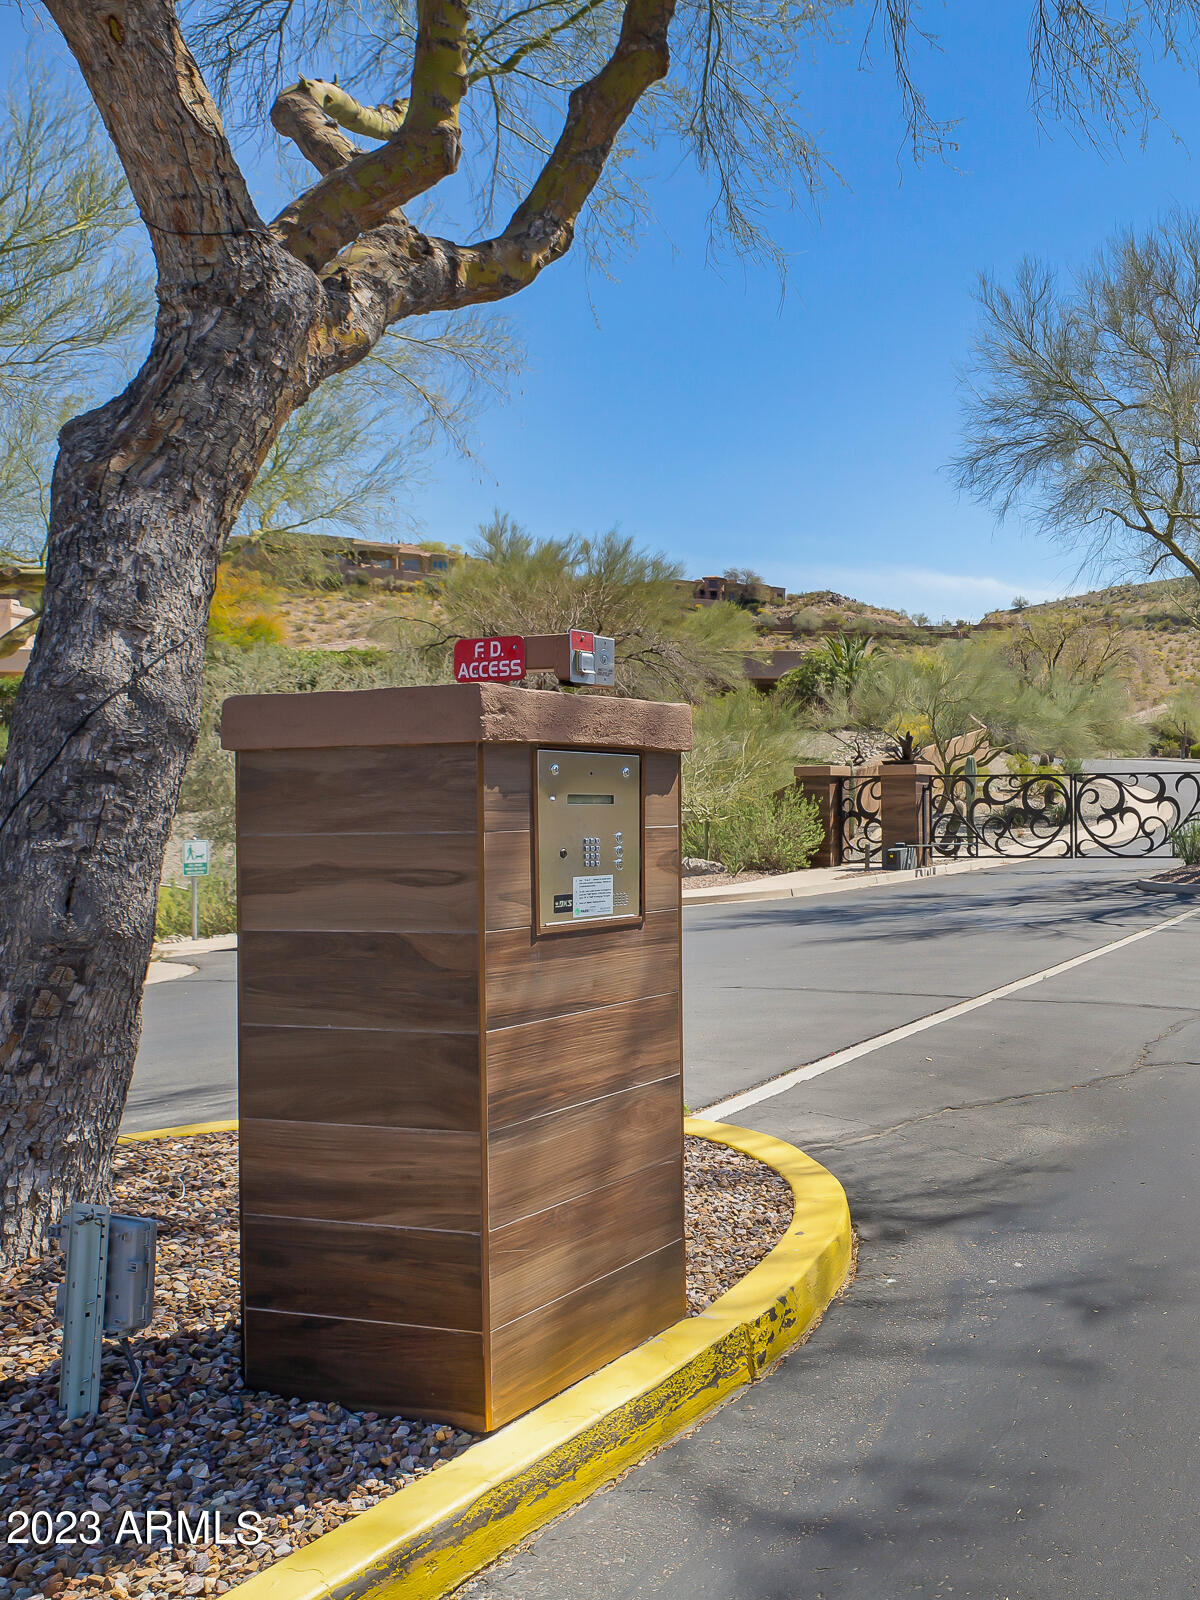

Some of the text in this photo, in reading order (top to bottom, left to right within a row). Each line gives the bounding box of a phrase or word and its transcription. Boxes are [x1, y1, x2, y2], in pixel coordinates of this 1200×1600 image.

[474, 641, 505, 658] F. D.
[458, 659, 522, 679] ACCESS
